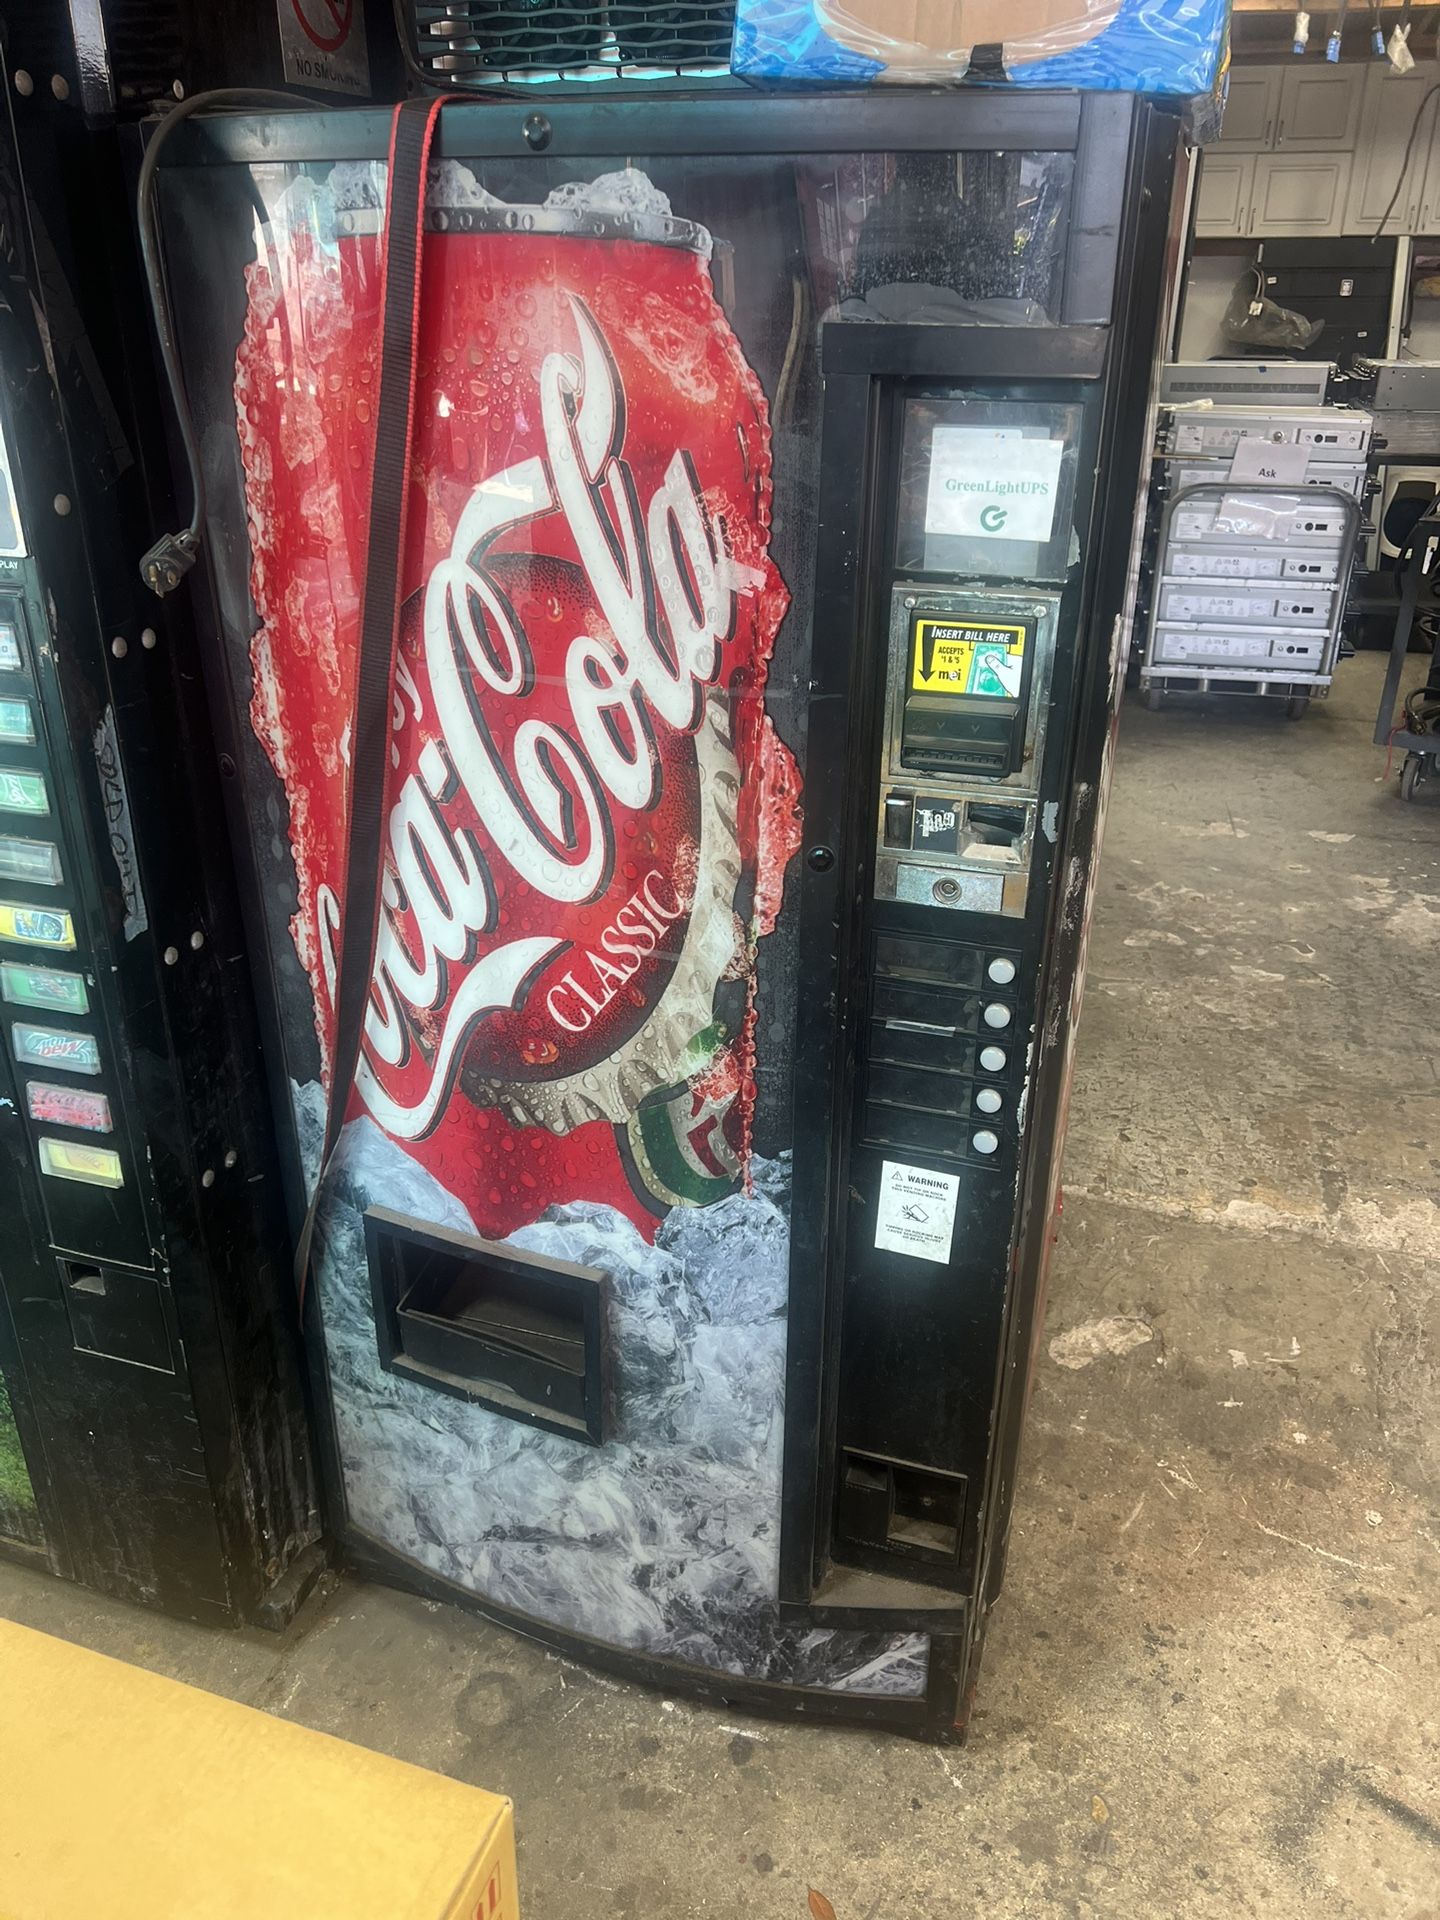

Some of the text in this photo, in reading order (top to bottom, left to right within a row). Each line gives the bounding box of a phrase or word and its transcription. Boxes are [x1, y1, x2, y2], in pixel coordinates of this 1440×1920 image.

[296, 58, 312, 76] NO
[1258, 468, 1277, 479] Ask
[945, 478, 1049, 496] GreenLightUPS
[931, 626, 963, 640] INSERT
[964, 630, 984, 642] BILL
[986, 632, 1011, 643] HERE
[938, 646, 964, 656] ACCEPTS
[938, 668, 961, 681] mei
[546, 869, 685, 1032] CLASSIC
[907, 1175, 949, 1190] WARNING
